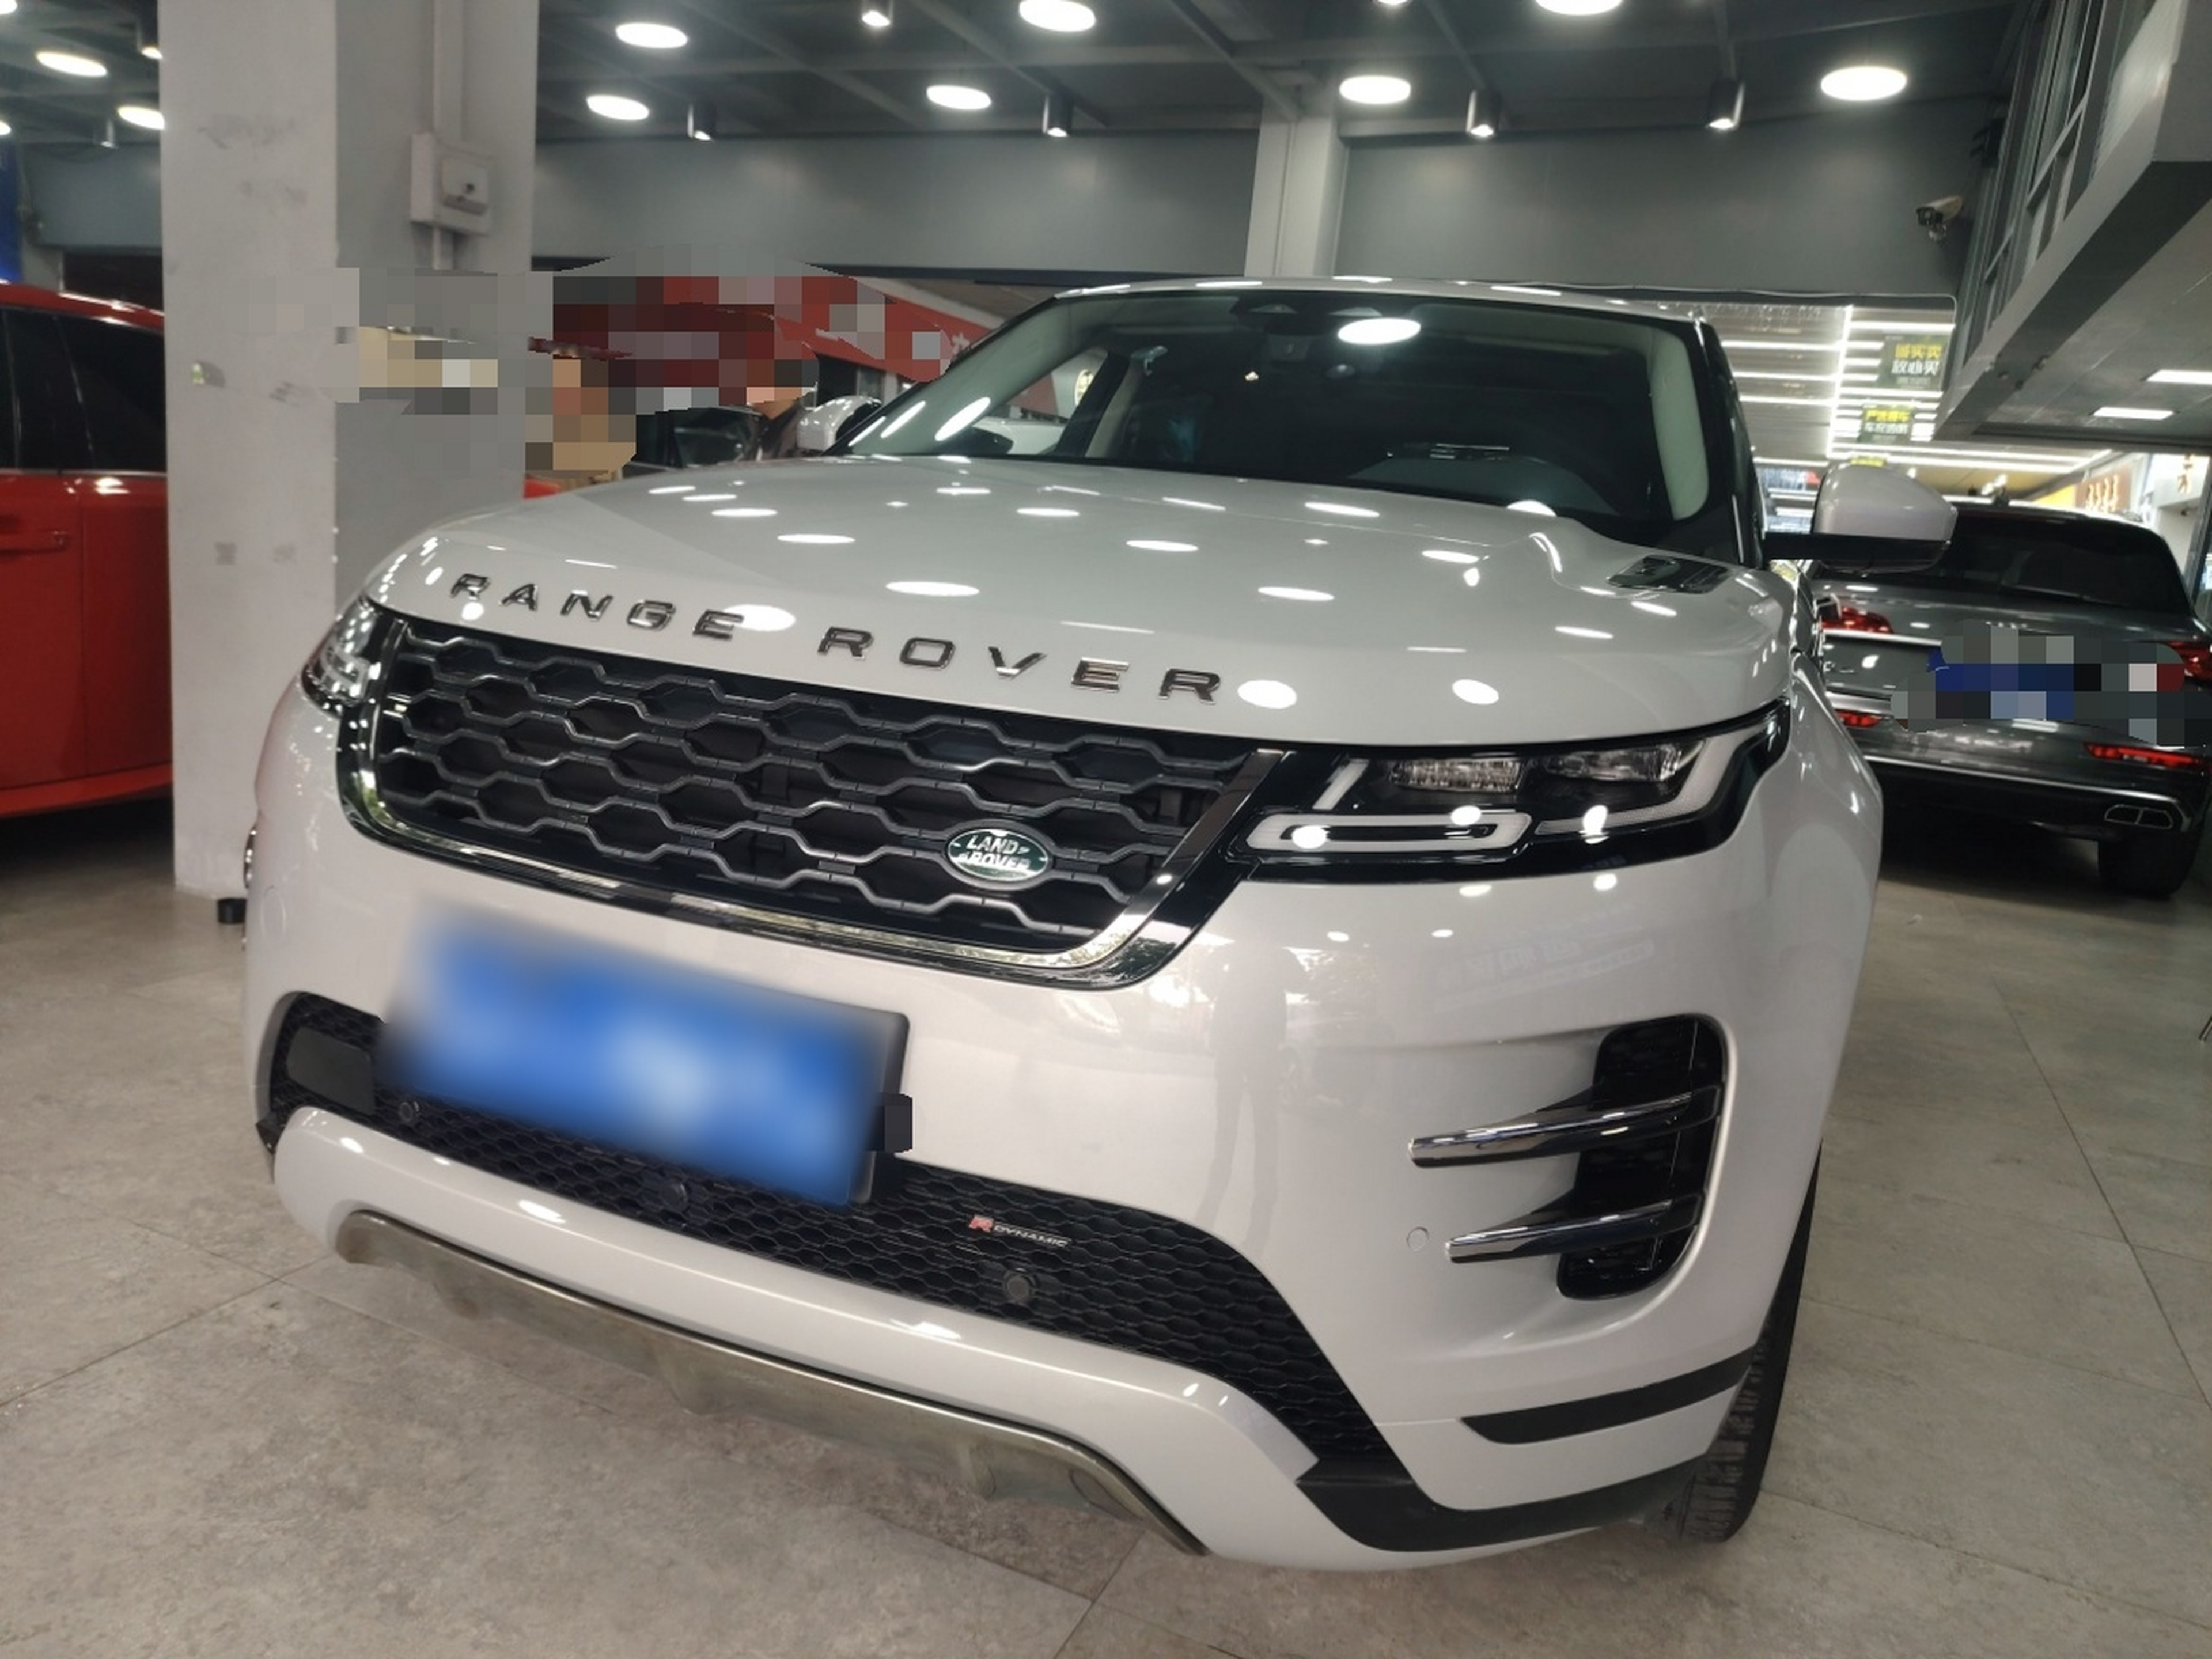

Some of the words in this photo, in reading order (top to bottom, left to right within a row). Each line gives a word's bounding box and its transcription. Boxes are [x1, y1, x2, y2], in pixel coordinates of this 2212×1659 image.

[450, 573, 744, 641] RANGE
[817, 626, 1222, 705] ROVER
[966, 835, 1020, 855] LAND
[969, 851, 1031, 870] ROVER
[994, 1225, 1069, 1248] DYNAMIC
